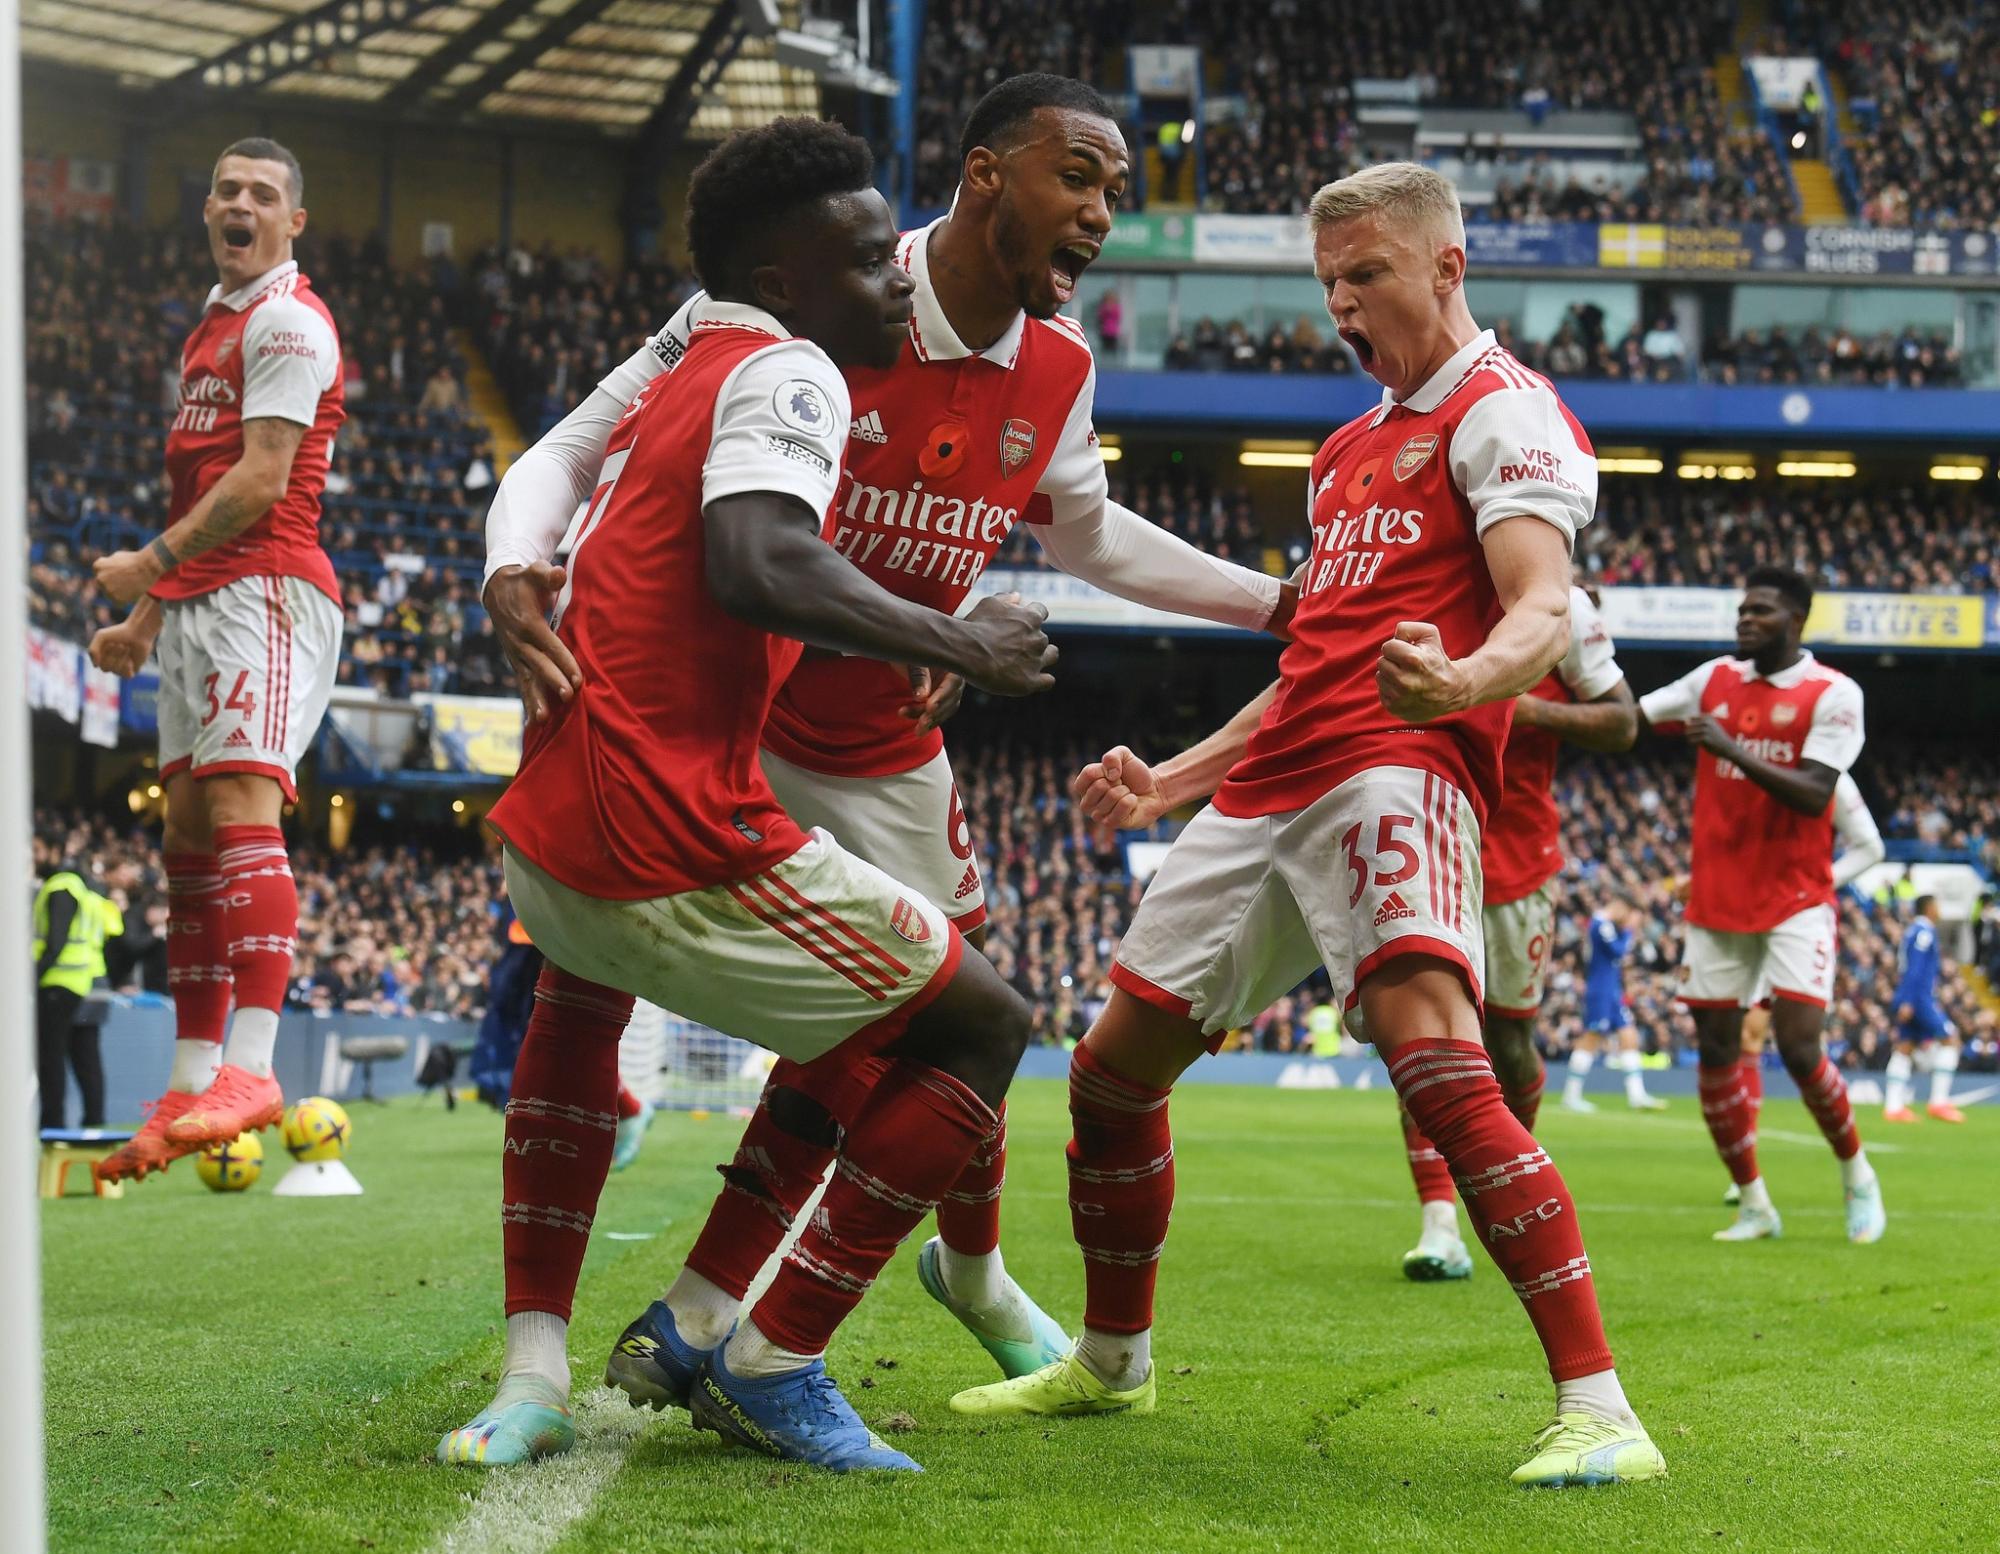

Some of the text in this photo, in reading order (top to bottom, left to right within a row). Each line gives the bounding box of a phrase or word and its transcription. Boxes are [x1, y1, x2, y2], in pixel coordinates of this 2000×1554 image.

[1804, 227, 1914, 251] CORNISH
[1804, 250, 1880, 274] BLUES
[271, 331, 307, 342] VISIT
[1007, 427, 1033, 443] Arsenal
[766, 435, 826, 470] No room
[1520, 451, 1562, 473] VISIT
[835, 468, 1018, 544] mirates
[884, 536, 985, 588] BETTER
[1844, 618, 1960, 636] BLUES
[201, 669, 256, 727] 34
[947, 781, 973, 860] 6
[1341, 814, 1420, 910] 35
[1373, 908, 1416, 927] adidas
[1527, 934, 1544, 978] 9
[503, 1136, 580, 1159] AFC
[1488, 1197, 1563, 1242] AFC
[703, 1376, 732, 1408] new
